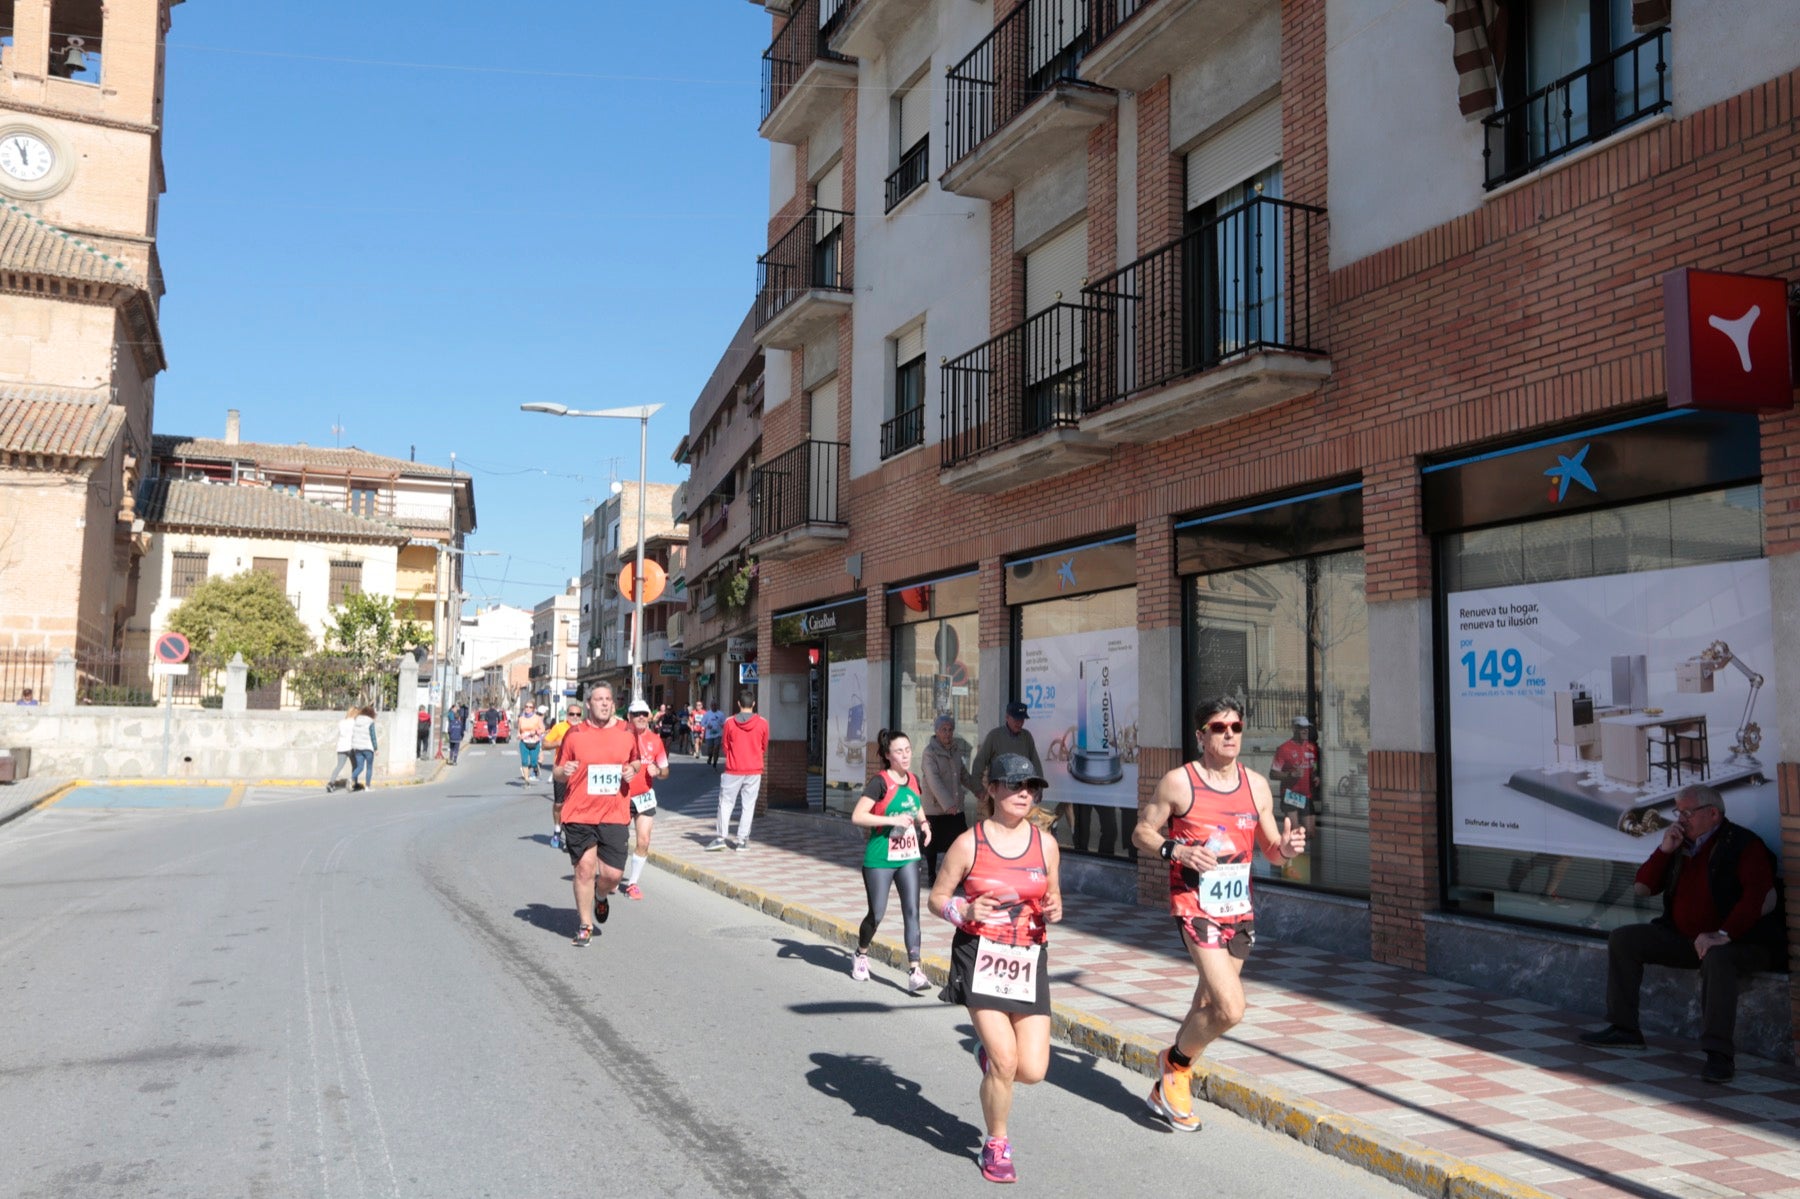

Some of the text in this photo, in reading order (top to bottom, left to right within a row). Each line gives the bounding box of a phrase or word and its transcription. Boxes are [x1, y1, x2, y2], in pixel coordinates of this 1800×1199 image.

[1460, 603, 1539, 618] Renueva tu hogar,
[808, 611, 837, 630] CaixaBank
[1460, 615, 1538, 631] renueva tu ilusión
[1460, 639, 1473, 649] por
[1461, 648, 1523, 688] 149
[1102, 666, 1109, 687] 5G
[1526, 678, 1546, 687] mes
[592, 774, 618, 784] 1151
[1465, 818, 1490, 826] Disfrutar
[1491, 820, 1498, 828] de
[1507, 821, 1519, 829] vida
[891, 836, 916, 850] 2061
[1210, 880, 1243, 900] 410
[979, 954, 1031, 983] 2091
